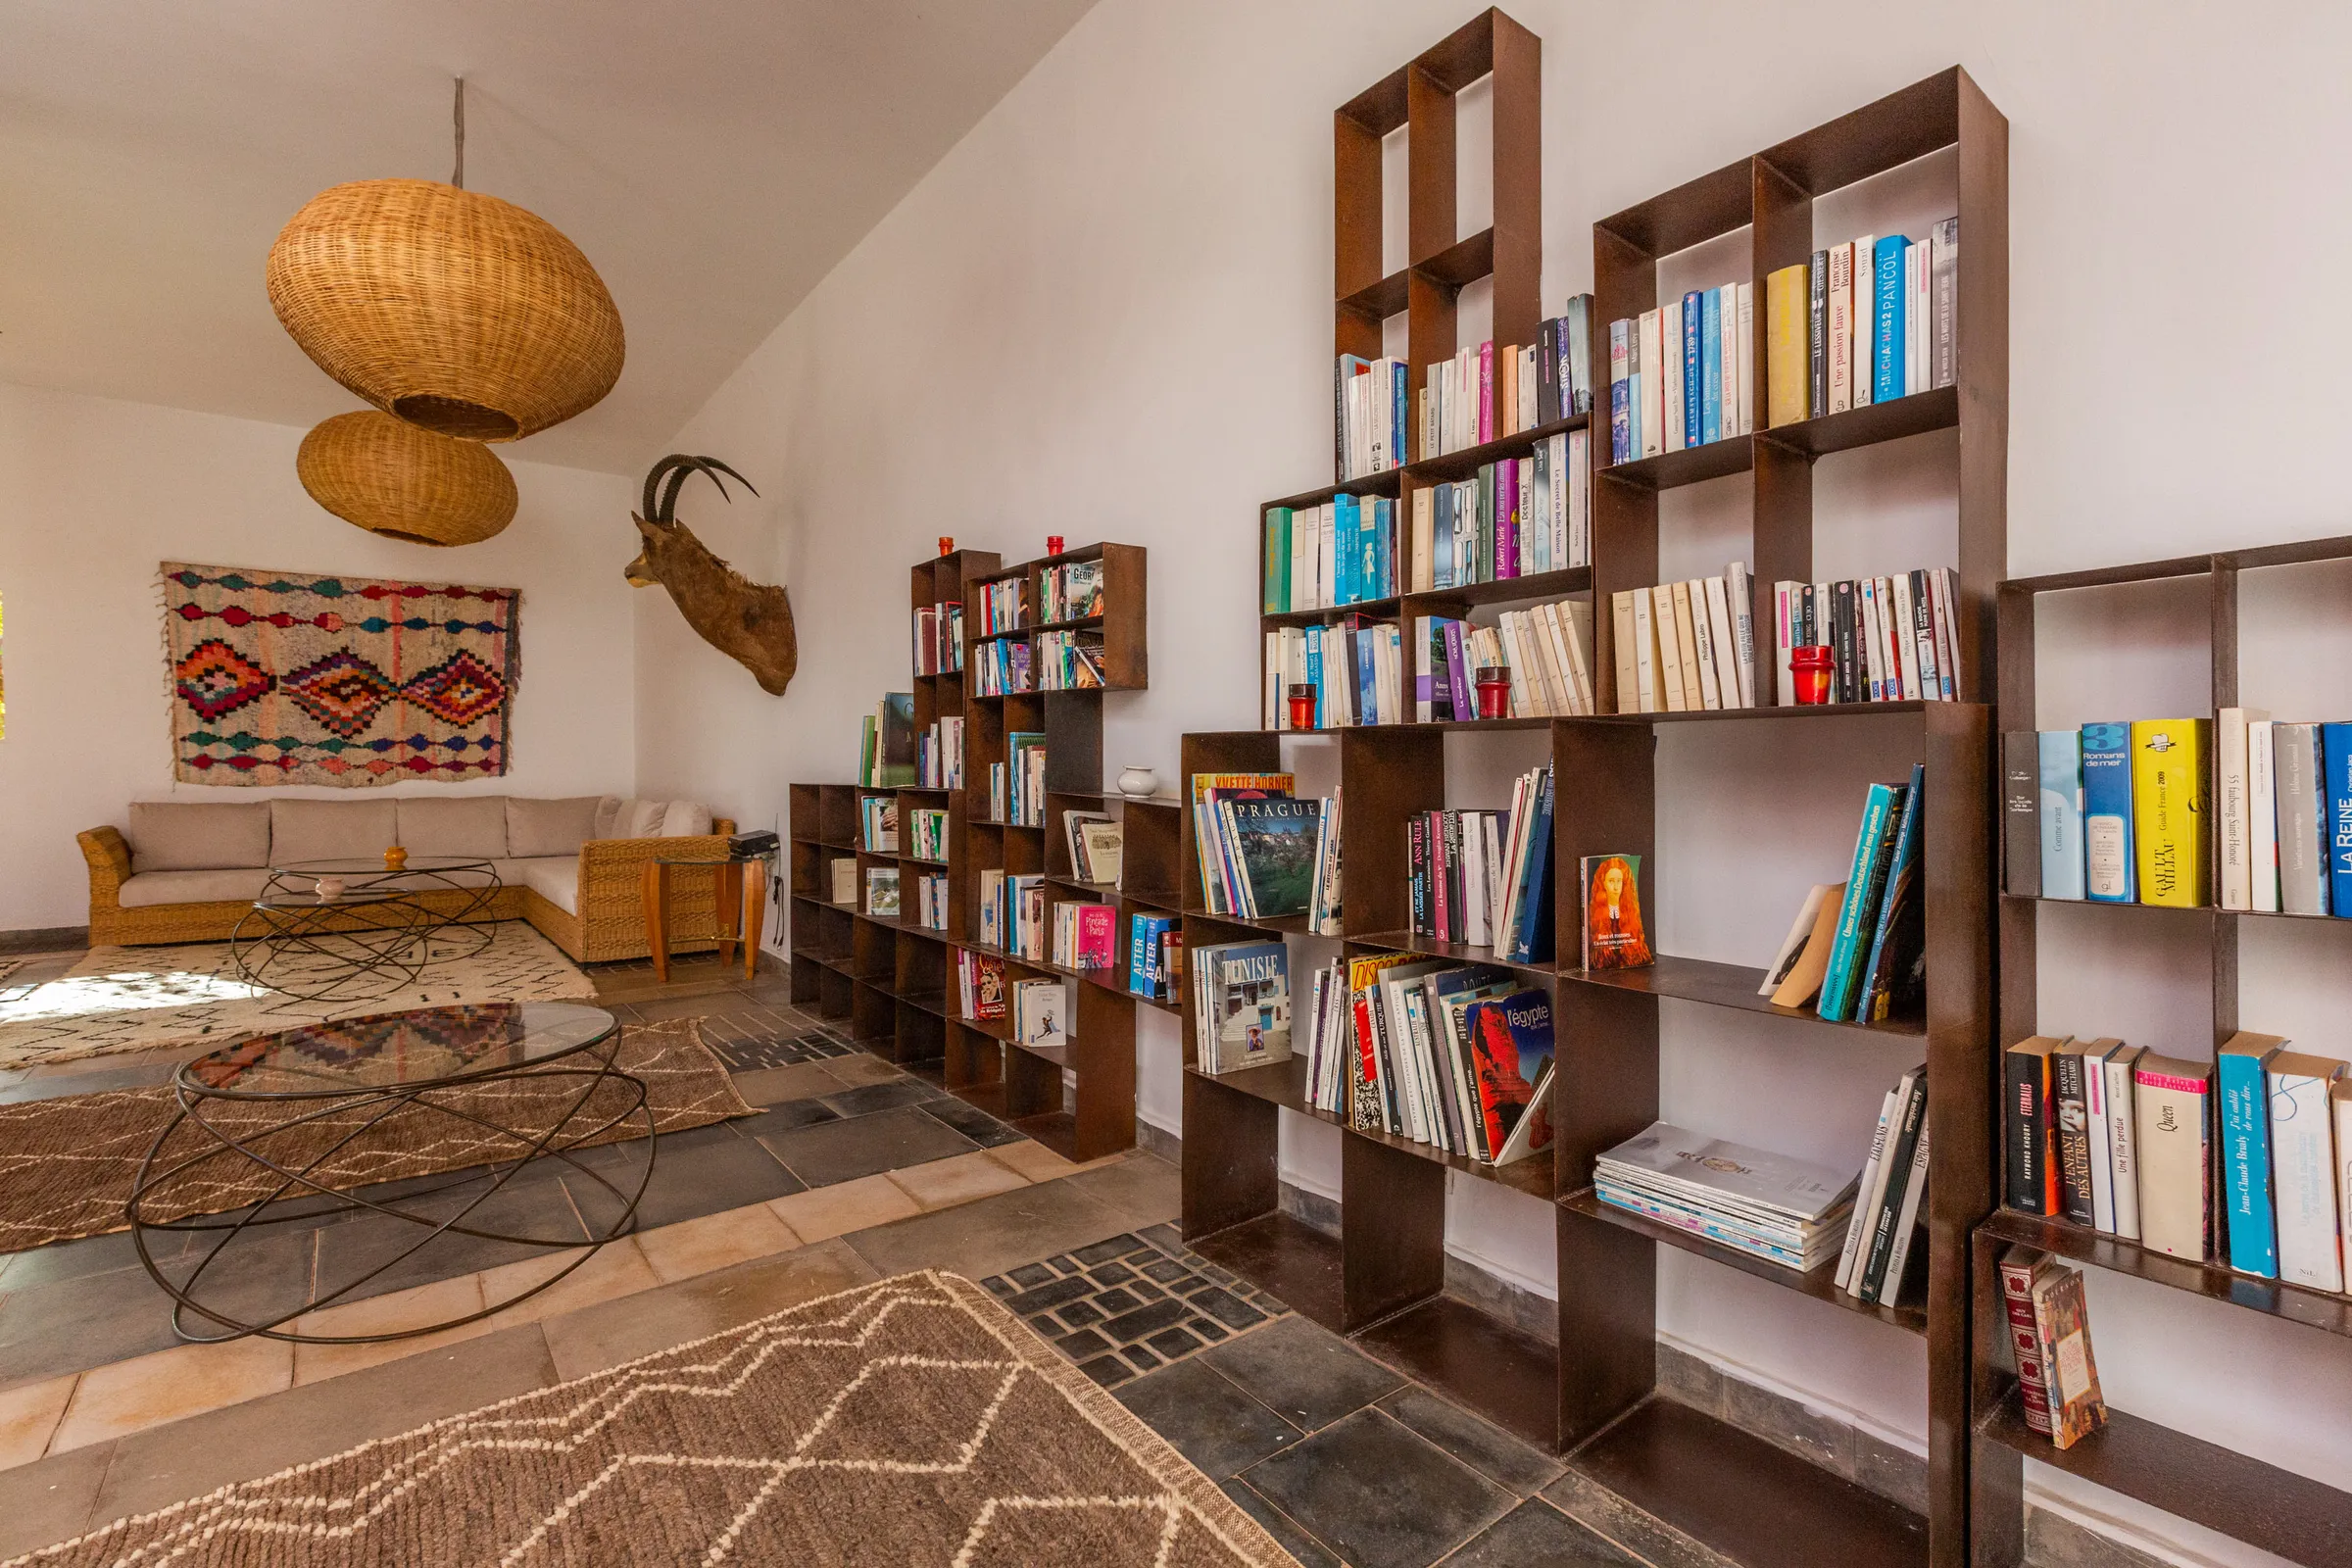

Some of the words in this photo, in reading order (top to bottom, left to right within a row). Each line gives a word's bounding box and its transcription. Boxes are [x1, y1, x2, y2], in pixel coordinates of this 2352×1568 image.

[1831, 251, 1841, 292] Françoise
[1840, 251, 1849, 286] Bourdin
[1883, 251, 1896, 309] PANCOL
[1834, 306, 1843, 330] fauve
[1687, 337, 1695, 355] 1789
[1835, 332, 1846, 366] passion
[1835, 368, 1843, 387] Une
[1496, 512, 1505, 522] En
[1495, 526, 1505, 547] Merle
[1495, 548, 1505, 570] Robert
[1700, 639, 1709, 661] Philippe
[1215, 776, 1251, 788] YVETTE
[1254, 776, 1294, 791] HORNER
[1237, 804, 1317, 817] PRAGUE
[1868, 805, 1882, 834] gesehen
[2336, 798, 2352, 847] REINE
[1225, 803, 1243, 860] PRAGUE
[1413, 820, 1422, 843] RULE
[1864, 834, 1875, 847] neu
[2052, 825, 2063, 852] Comme
[1414, 845, 1423, 864] ANN
[2164, 839, 2176, 891] MILLAU
[2337, 852, 2352, 873] LA
[1852, 847, 1871, 890] Deutschland
[2155, 849, 2166, 897] GAULT
[1848, 890, 1863, 916] schönes
[1842, 917, 1856, 937] Unser
[1134, 938, 1144, 975] AFTER
[1147, 942, 1155, 980] AFTER
[1222, 955, 1279, 985] TUNISIE
[1376, 1002, 1386, 1036] TURQUIE
[1507, 1004, 1548, 1027] l'égypte
[2058, 1058, 2070, 1095] JACQUELYN
[2068, 1060, 2079, 1095] MITCHARD
[2019, 1082, 2034, 1116] ETERNALIS
[2228, 1089, 2239, 1113] oublié
[1473, 1103, 1482, 1128] l'égypte
[2156, 1105, 2178, 1132] Queen
[2023, 1124, 2032, 1149] KHOURY
[2114, 1117, 2126, 1142] perdue
[2062, 1133, 2078, 1186] L'ENFANT
[2075, 1136, 2088, 1177] AUTRES
[2115, 1144, 2129, 1158] fille
[2235, 1135, 2249, 1160] Brialy
[2024, 1151, 2033, 1180] RAYMOND
[2117, 1159, 2128, 1173] Une
[2078, 1178, 2090, 1200] DES
[2237, 1161, 2252, 1215] Jean-Claude
